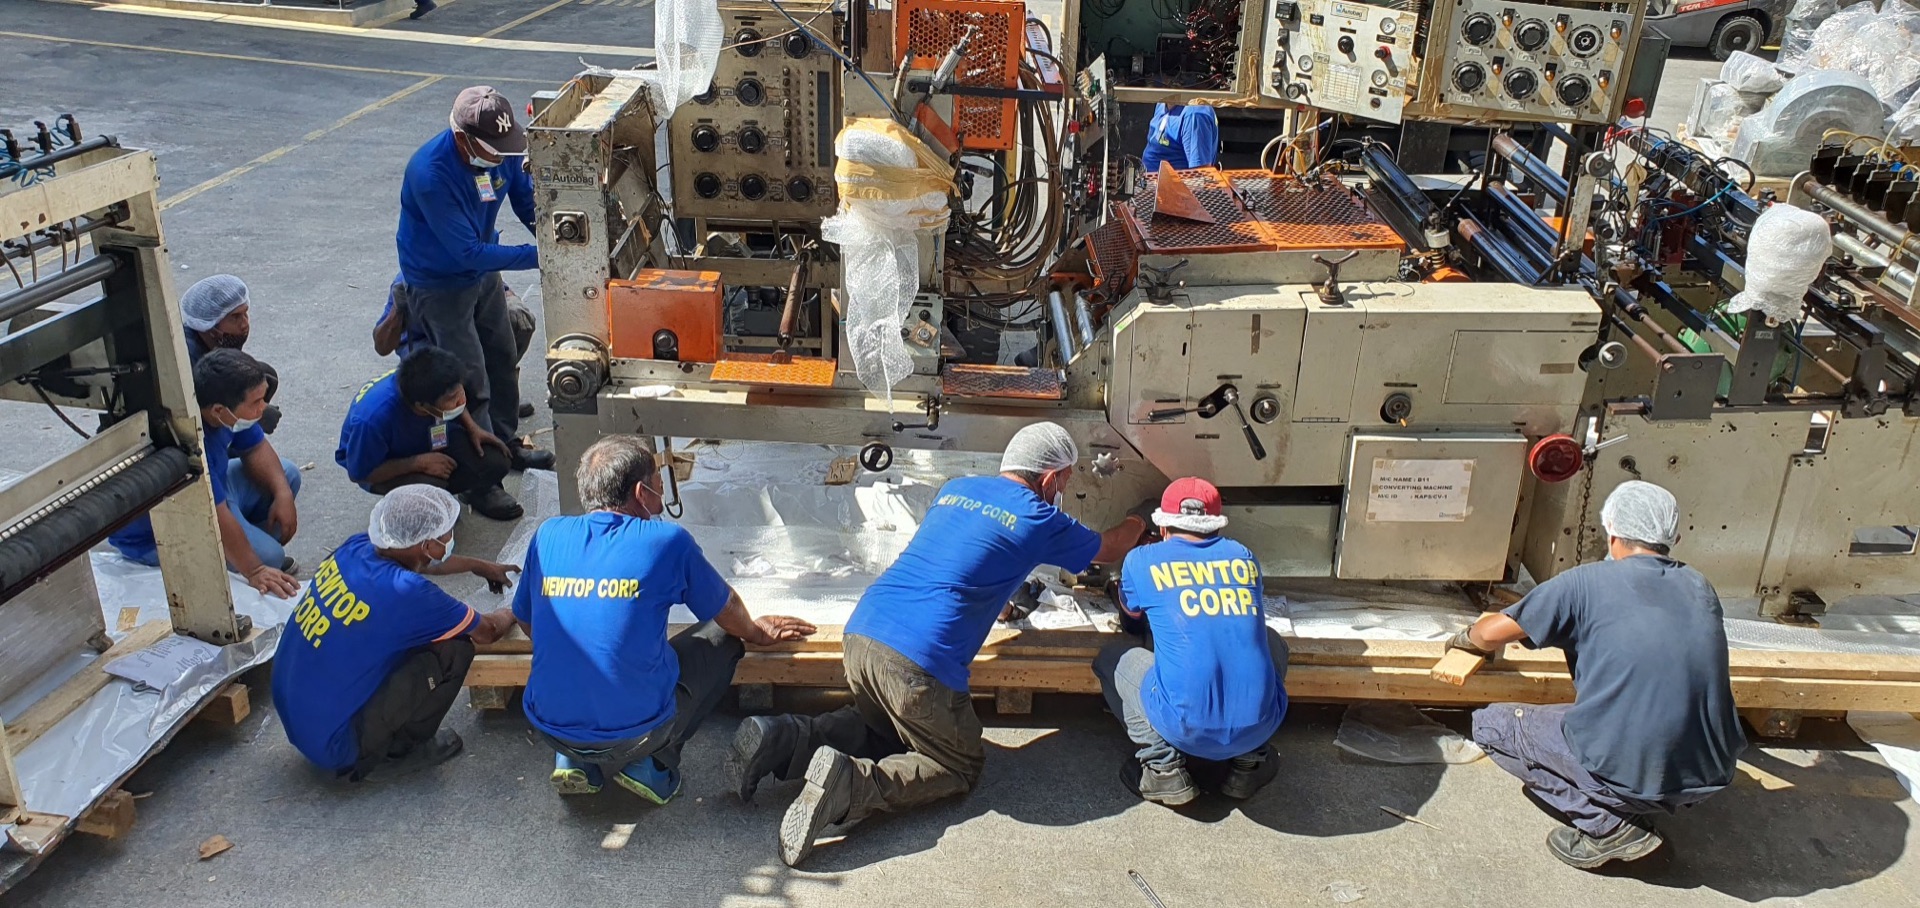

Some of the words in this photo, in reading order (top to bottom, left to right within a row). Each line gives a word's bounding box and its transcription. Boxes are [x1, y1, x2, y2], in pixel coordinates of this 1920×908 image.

[1341, 8, 1363, 18] Autobag
[1680, 2, 1701, 12] TCM
[495, 111, 512, 133] NY
[552, 173, 594, 186] Autobag
[981, 504, 1017, 531] CORP.
[1150, 559, 1258, 591] NEWTOP
[542, 576, 594, 598] NEWTOP
[598, 578, 639, 598] CORP.
[1180, 588, 1257, 616] CORP.
